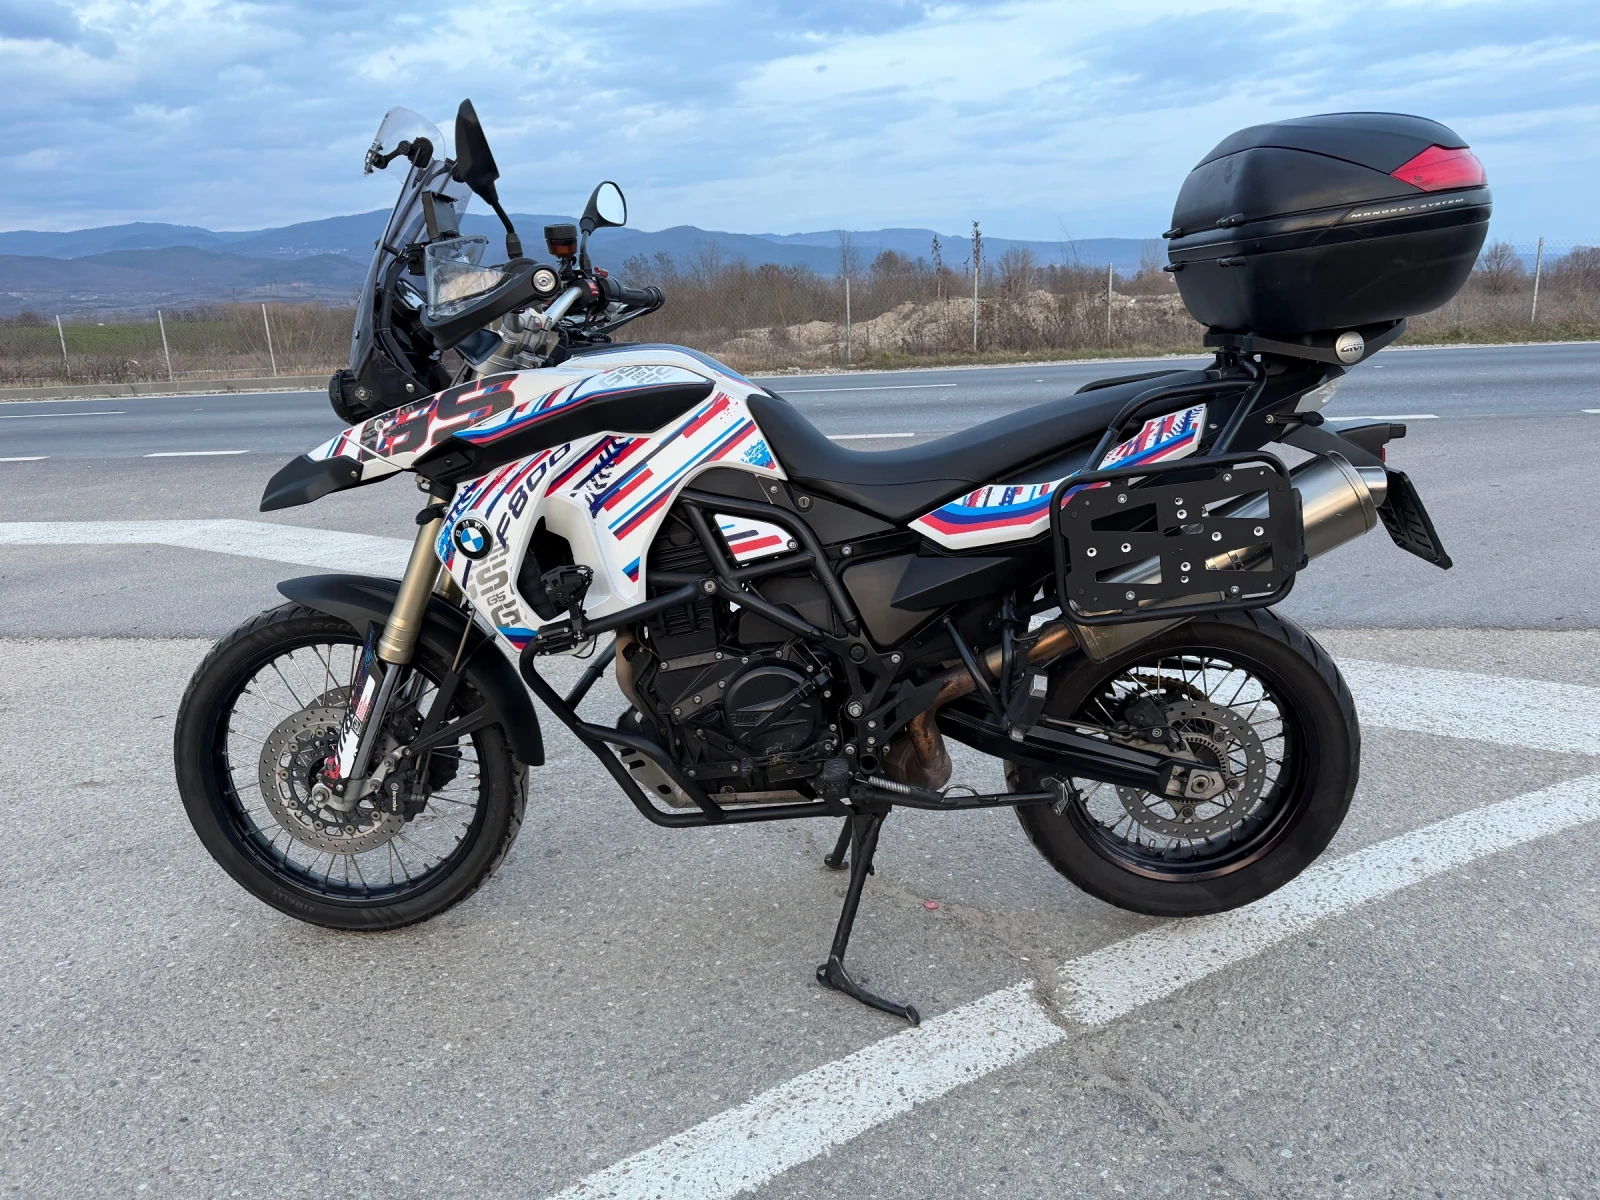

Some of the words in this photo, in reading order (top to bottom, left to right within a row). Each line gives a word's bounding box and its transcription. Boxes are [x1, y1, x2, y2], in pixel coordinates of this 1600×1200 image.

[1420, 198, 1464, 208] SYSTEM
[1340, 341, 1362, 352] GIVI
[496, 442, 571, 549] F800
[455, 520, 483, 538] BMW
[487, 590, 507, 607] GS
